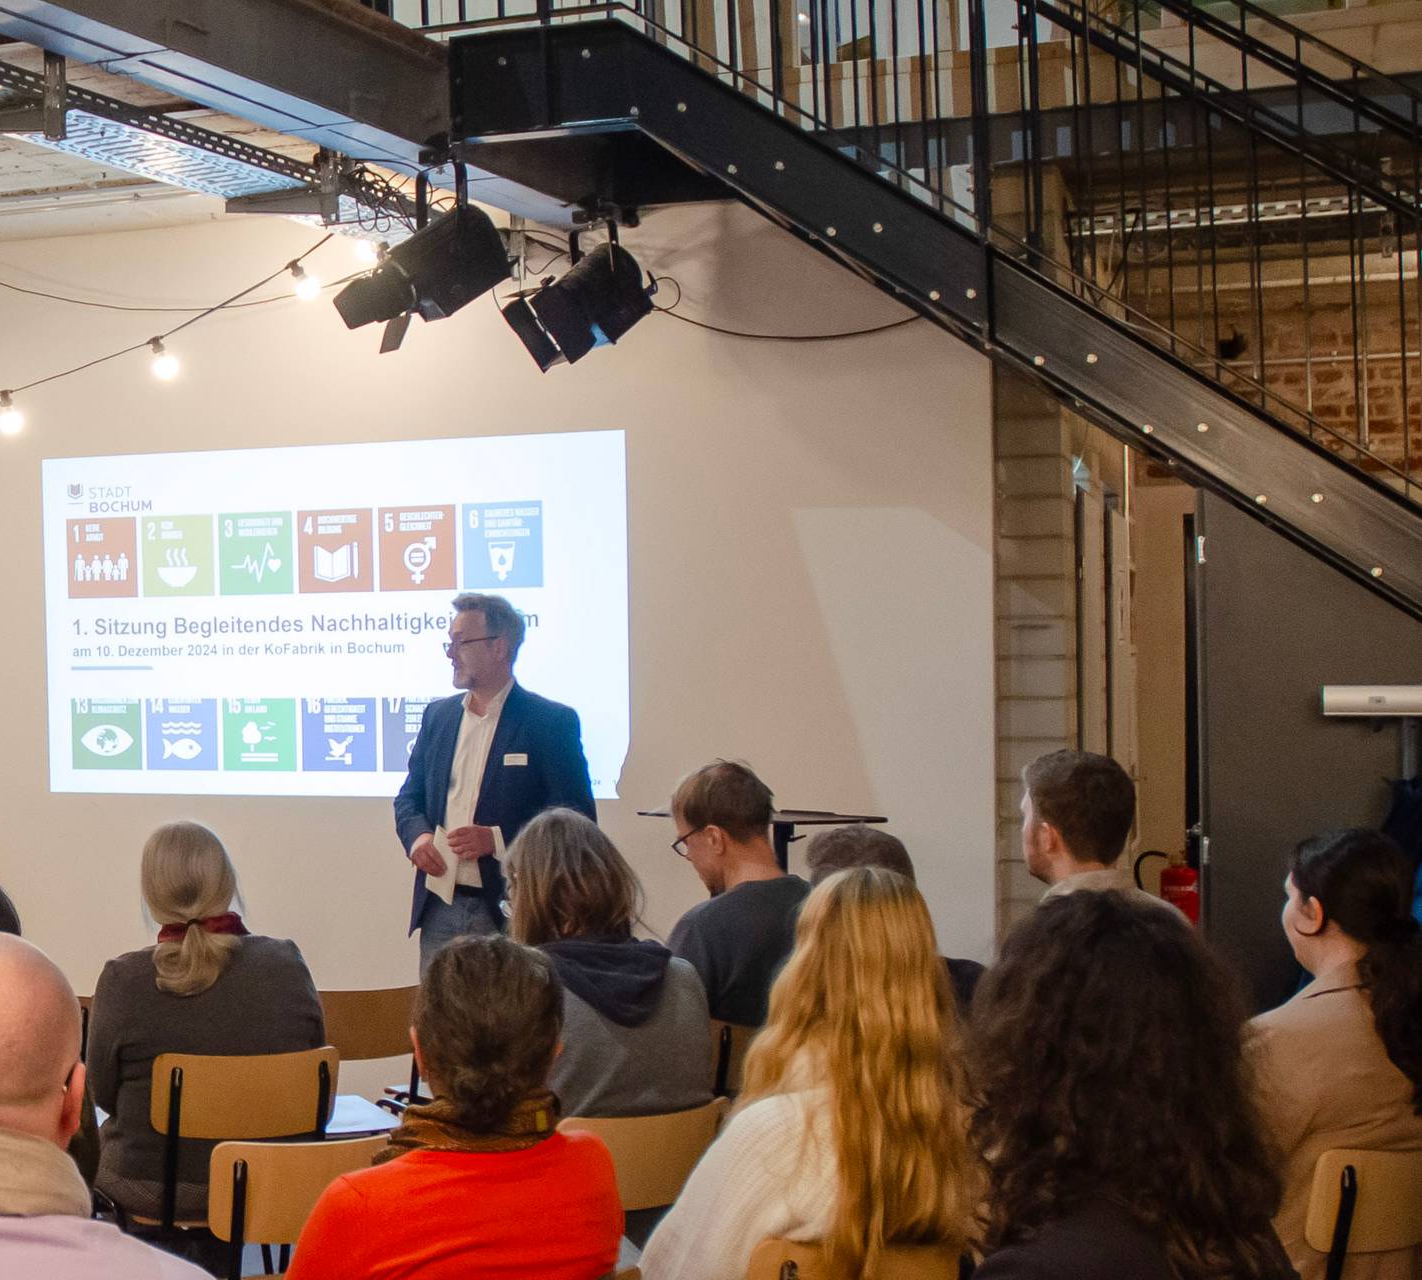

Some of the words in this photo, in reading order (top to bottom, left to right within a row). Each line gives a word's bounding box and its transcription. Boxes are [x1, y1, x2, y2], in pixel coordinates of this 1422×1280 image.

[89, 486, 132, 499] STADT
[89, 500, 153, 513] BOCHUM
[224, 519, 234, 538] 3
[303, 516, 314, 536] 4
[384, 512, 394, 533] 5
[469, 509, 479, 529] 6
[73, 524, 80, 544] 1
[146, 521, 156, 541] 2
[73, 618, 88, 636] 1.
[94, 617, 167, 639] Sitzung
[174, 615, 304, 638] Begleitendes
[72, 647, 92, 657] am
[96, 645, 114, 657] 10.
[118, 644, 184, 657] Dezember
[187, 644, 218, 657] 2024
[222, 643, 235, 656] in
[238, 643, 260, 656] der
[264, 642, 326, 656] KoFabrik
[330, 642, 343, 655] in
[347, 641, 406, 655] Bochum
